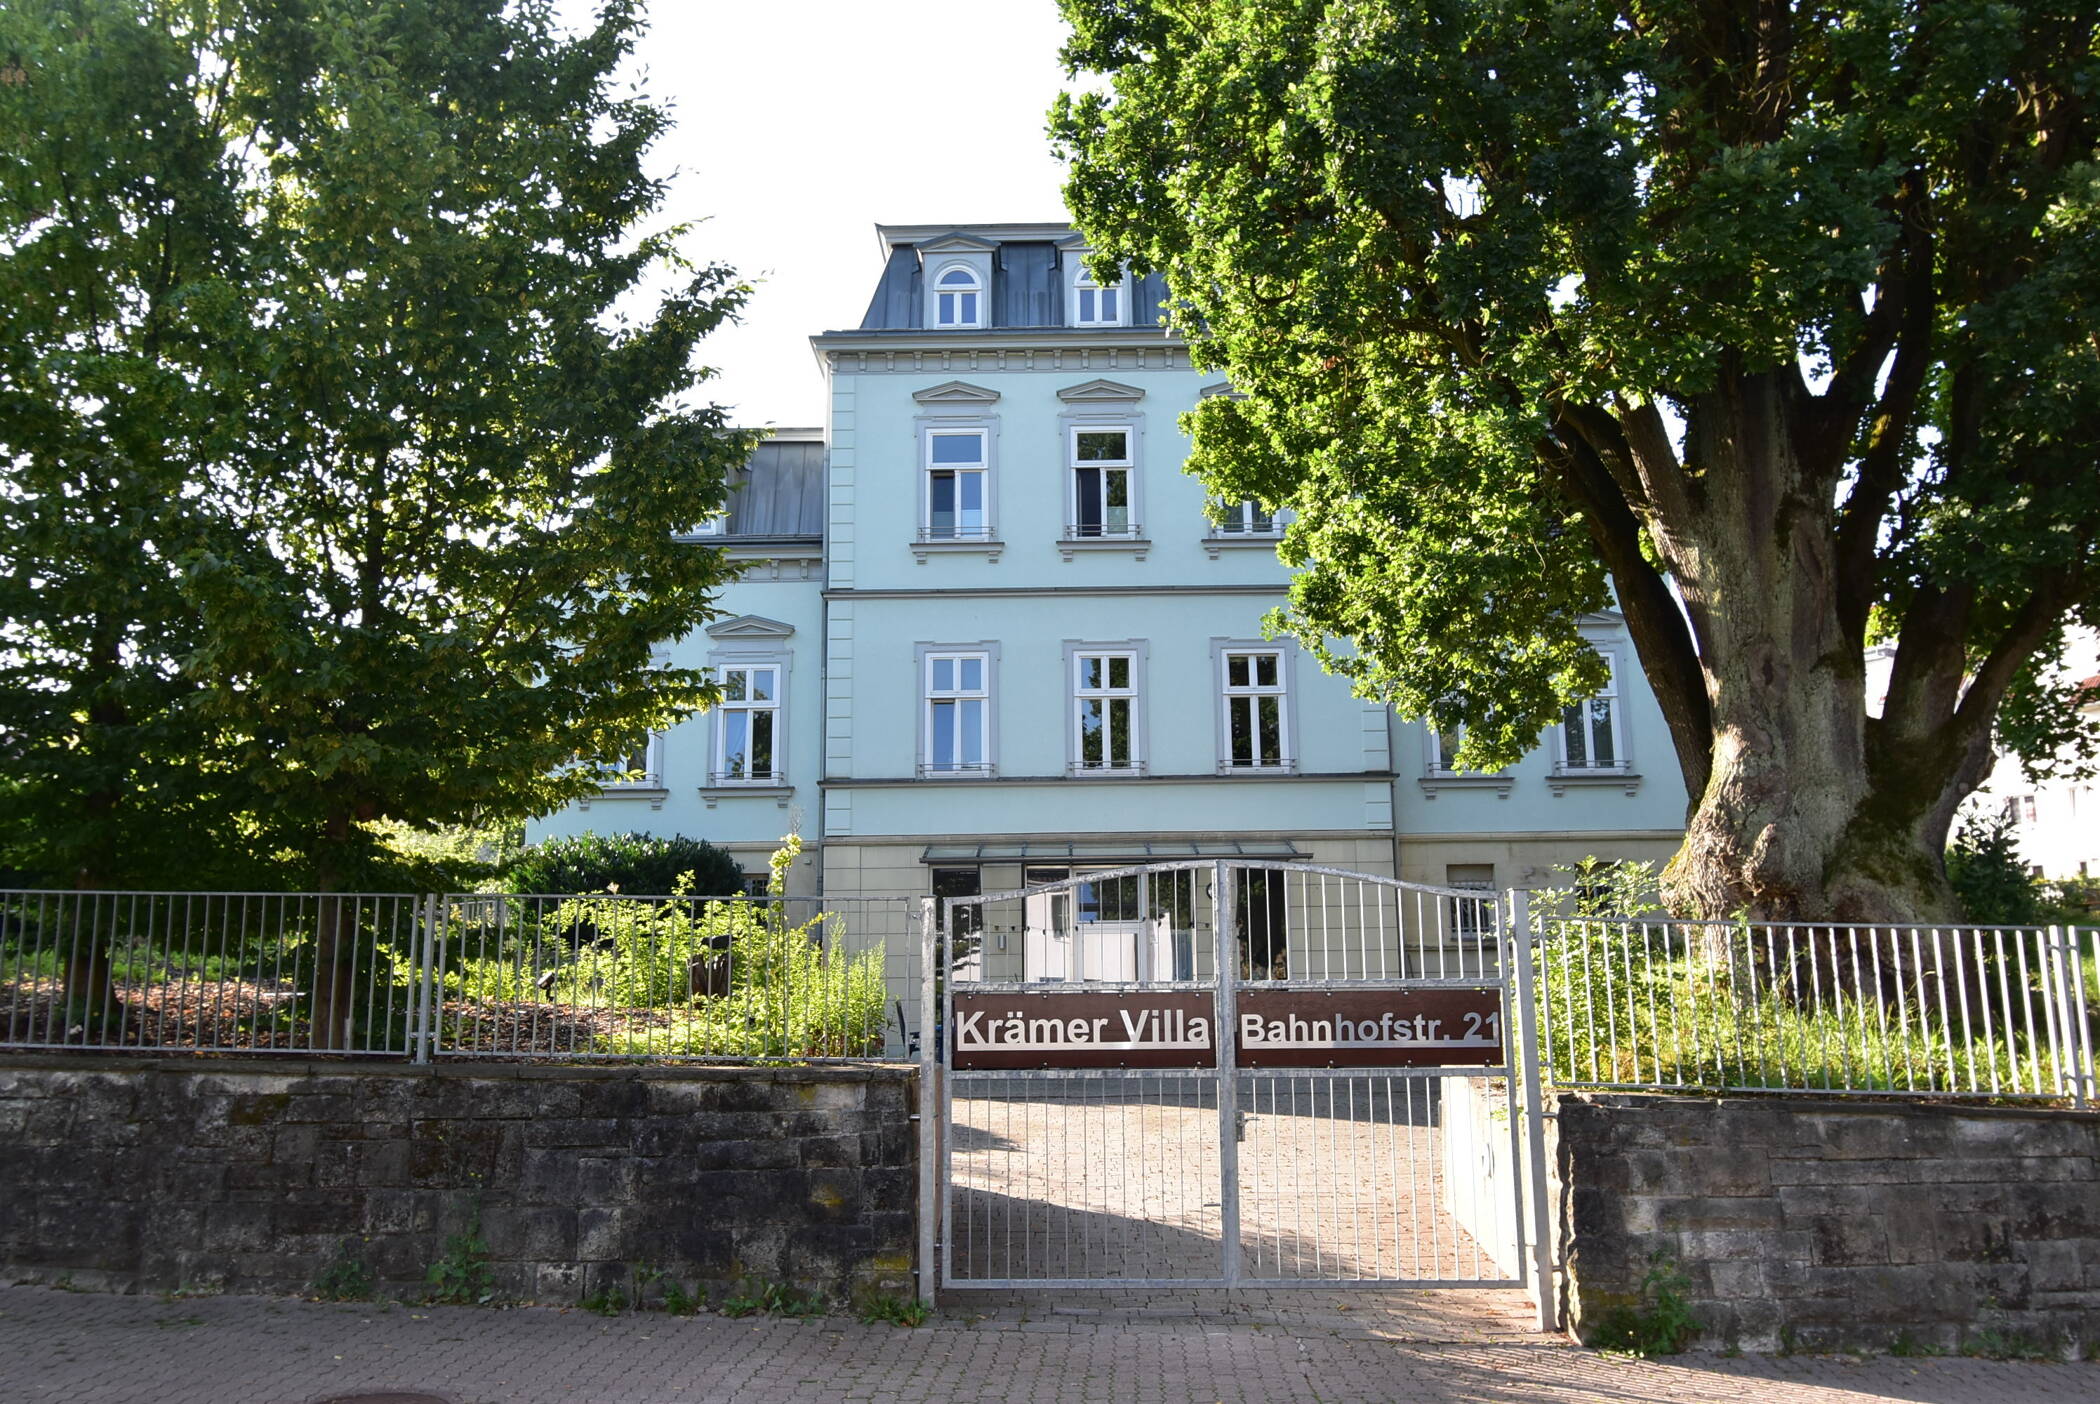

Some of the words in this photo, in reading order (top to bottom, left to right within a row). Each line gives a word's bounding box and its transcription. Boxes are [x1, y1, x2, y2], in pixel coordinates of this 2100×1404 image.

[957, 1010, 1108, 1044] Krämer
[1119, 1009, 1210, 1043] Villa
[1242, 1013, 1450, 1042] Bahnhofstr.
[1463, 1012, 1499, 1041] 21
